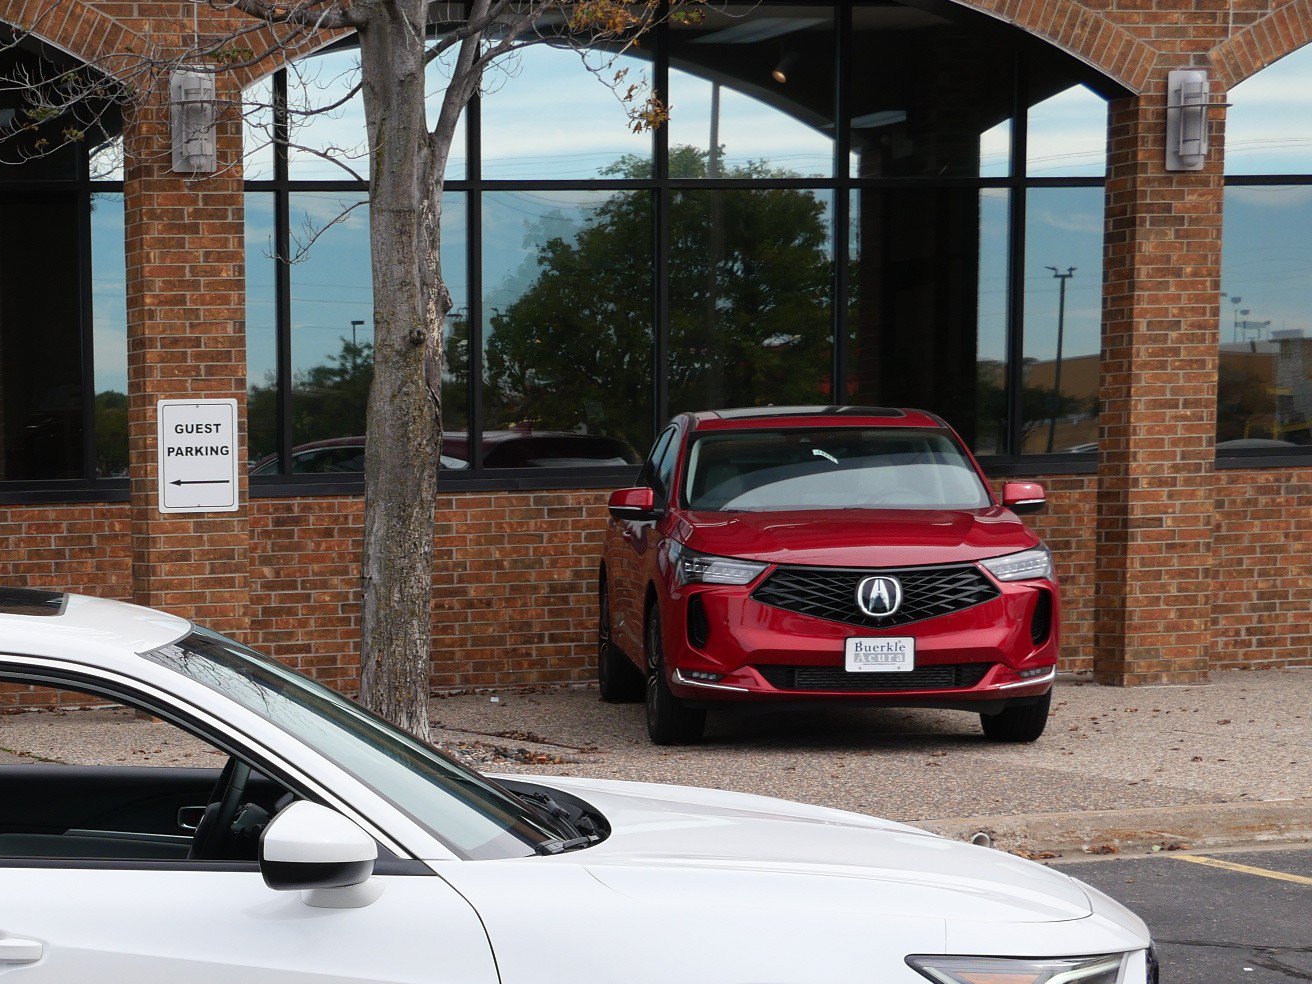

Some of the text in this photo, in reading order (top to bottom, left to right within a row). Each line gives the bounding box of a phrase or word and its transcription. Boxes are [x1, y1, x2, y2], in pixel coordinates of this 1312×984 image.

[174, 423, 222, 434] GUEST
[167, 446, 230, 457] PARKING
[855, 642, 906, 652] Buerkle
[856, 653, 904, 662] Acura
